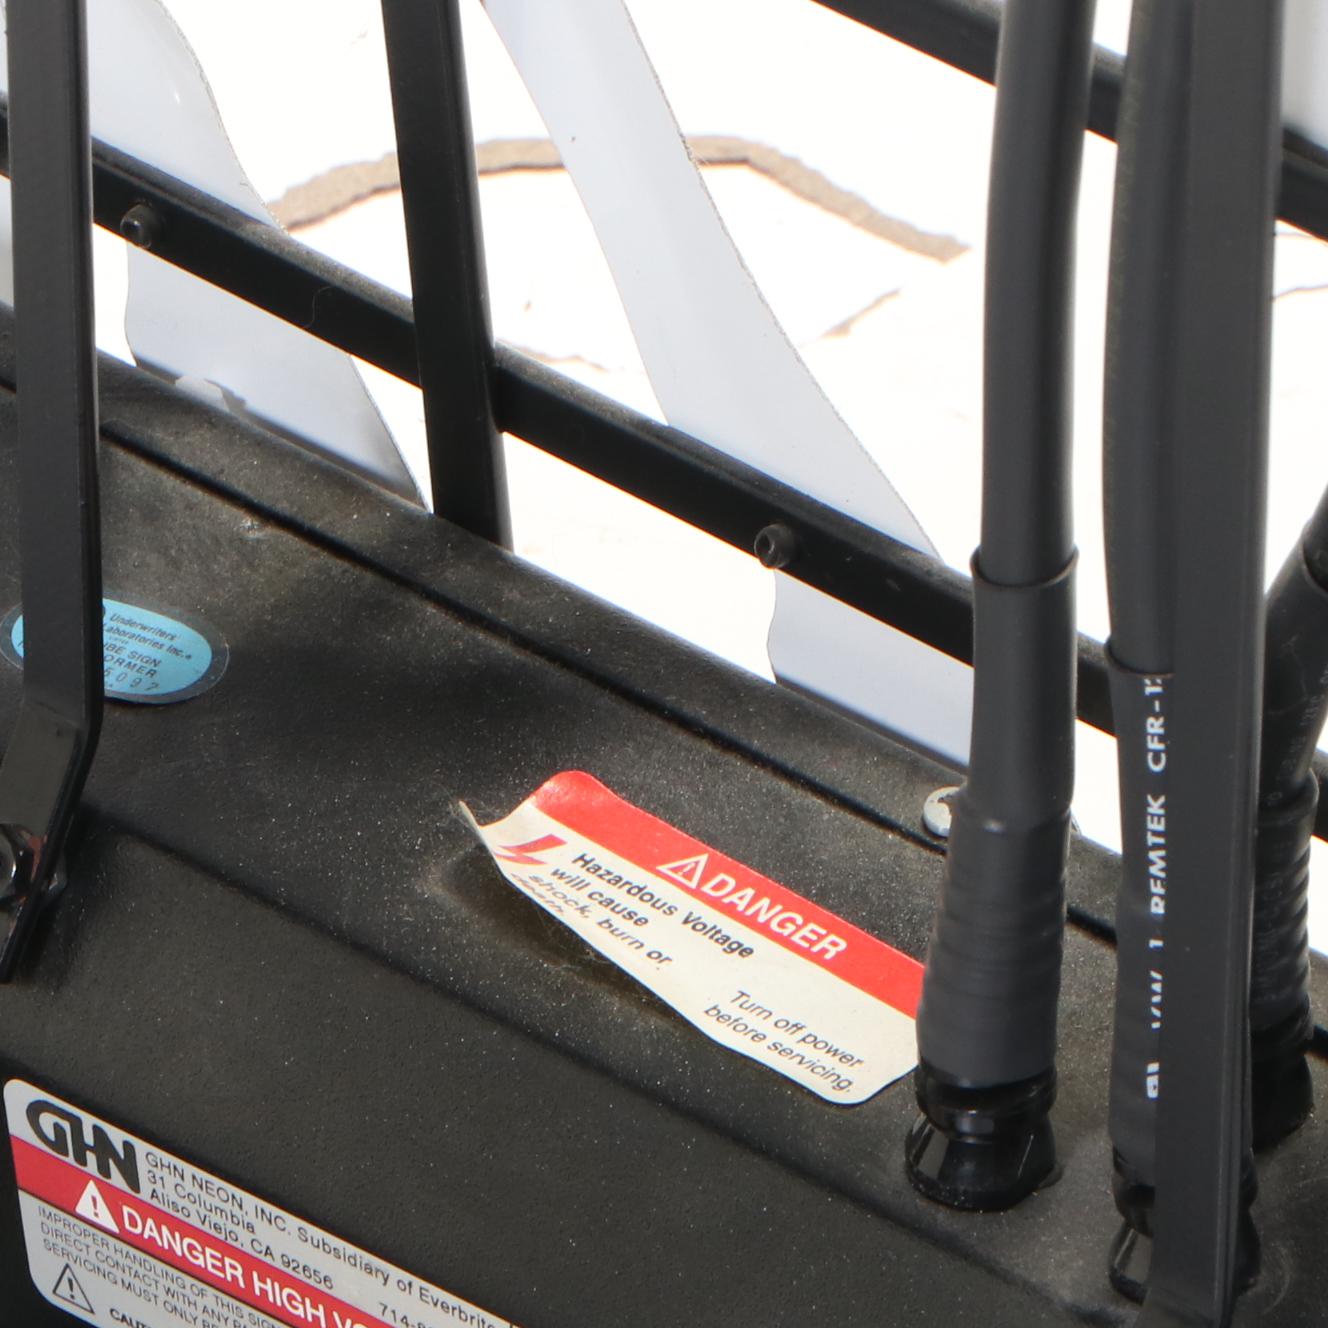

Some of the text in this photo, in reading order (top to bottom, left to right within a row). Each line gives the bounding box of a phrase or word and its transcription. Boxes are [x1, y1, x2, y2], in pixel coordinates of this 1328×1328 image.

[127, 650, 162, 668] SIGN
[551, 867, 648, 926] will cause
[572, 854, 754, 959] Hazardous Voltage
[701, 873, 847, 959] DANGER
[597, 919, 644, 949] burn
[647, 948, 672, 966] or
[704, 1005, 853, 1092] before servicing.
[731, 991, 863, 1071] Turn off power
[26, 1100, 140, 1194] GHN
[146, 1151, 184, 1182] GHN
[192, 1174, 247, 1217] NEON,
[255, 1205, 289, 1234] INC.
[298, 1227, 389, 1286] Subsidiary
[396, 1275, 412, 1295] of
[147, 1169, 255, 1234] 31 Columbia
[151, 1188, 190, 1218] Aliso
[196, 1210, 245, 1251] Viejo,
[251, 1237, 274, 1261] CA
[281, 1253, 333, 1289] 92656
[39, 1206, 109, 1250] IMPROPER
[114, 1244, 186, 1290] HANDLING
[190, 1282, 208, 1301] OF
[213, 1295, 244, 1318] THIS
[41, 1222, 90, 1256] DIRECT
[95, 1250, 159, 1290] CONTACT
[163, 1284, 197, 1310] WITH
[202, 1303, 229, 1326] ANY
[44, 1239, 117, 1285] SERVICING
[121, 1278, 158, 1306] MUST
[163, 1300, 198, 1326] ONLY
[123, 1206, 244, 1288] DANGER
[253, 1271, 326, 1328] HIGH
